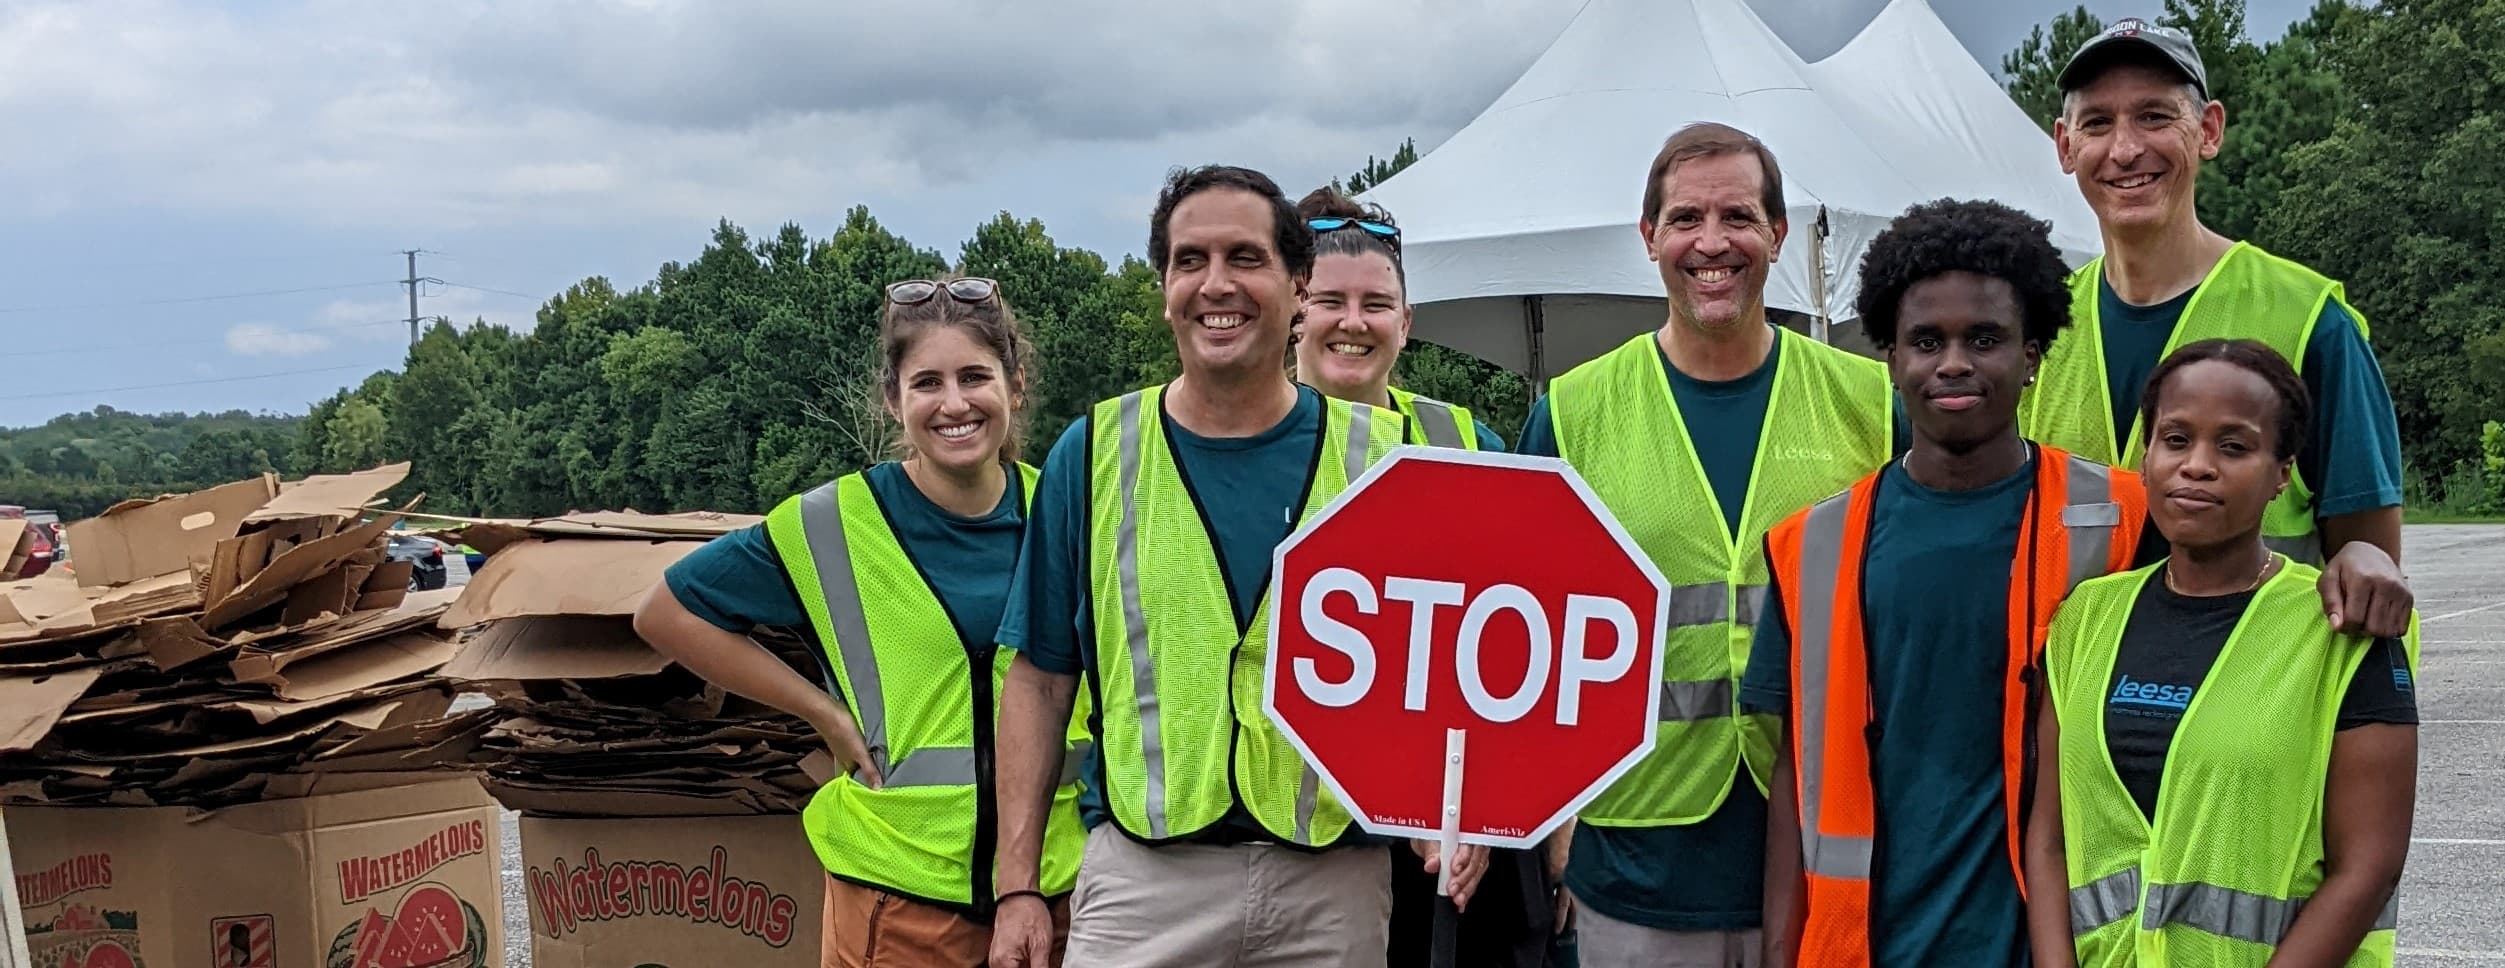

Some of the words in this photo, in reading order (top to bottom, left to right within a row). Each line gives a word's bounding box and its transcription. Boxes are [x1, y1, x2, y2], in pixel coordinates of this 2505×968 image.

[2140, 22, 2170, 38] LAKE
[1293, 567, 1639, 727] STOP
[2113, 674, 2193, 703] leesa
[1373, 814, 1397, 825] Made
[1398, 817, 1406, 825] in
[1408, 817, 1427, 828] USA
[1480, 824, 1526, 837] Ameri-Viz
[15, 852, 113, 905] ATERMELONS
[340, 819, 485, 902] WATERMELONS
[529, 847, 796, 945] Watermelons
